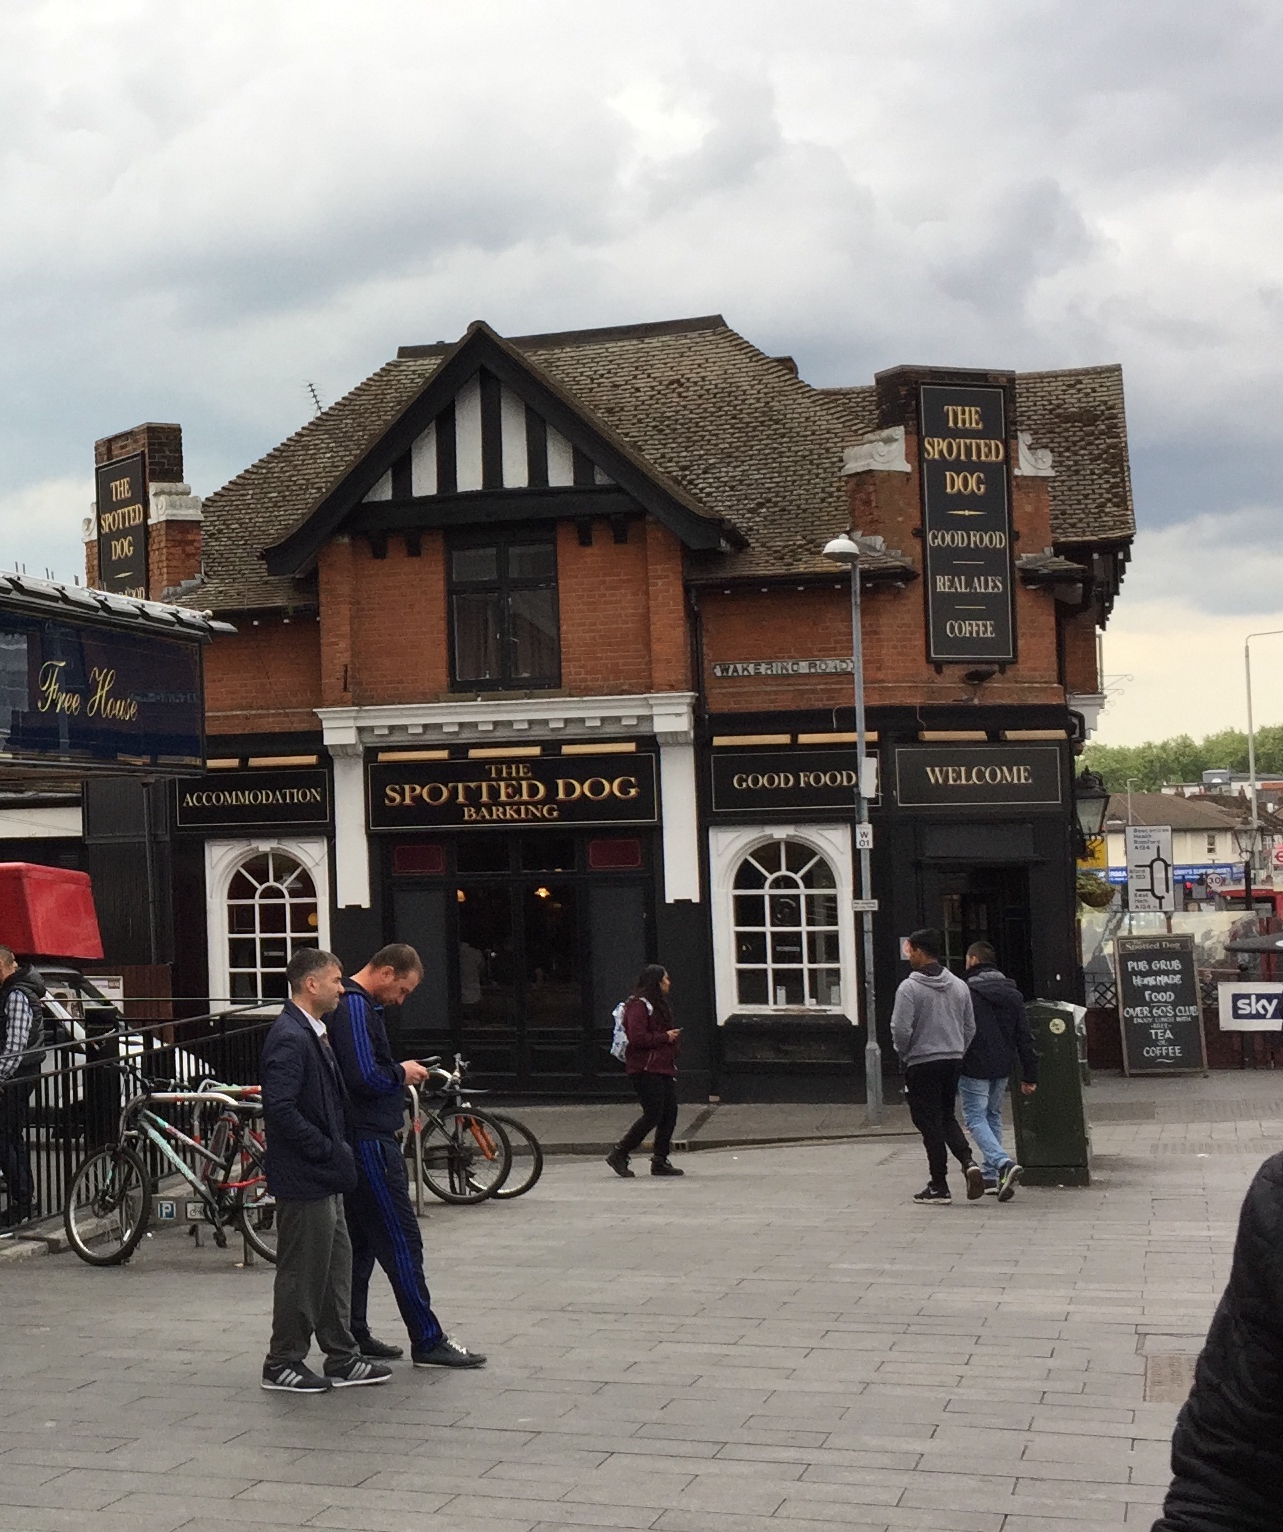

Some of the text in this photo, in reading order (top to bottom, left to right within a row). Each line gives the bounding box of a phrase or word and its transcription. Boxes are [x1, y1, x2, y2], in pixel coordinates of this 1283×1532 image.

[944, 405, 983, 431] THE
[924, 437, 1005, 463] SPOTTED
[110, 477, 132, 502] THE
[945, 471, 987, 496] DOG
[100, 503, 144, 534] SPOTTED
[928, 529, 1005, 548] GOOD FOOD
[111, 536, 134, 561] DOG
[935, 574, 1003, 593] REAL ALES
[946, 620, 995, 639] COFFEE
[719, 658, 849, 677] WAKERING ROAD
[38, 660, 139, 722] Free House
[485, 763, 533, 779] THE
[733, 770, 857, 789] GOOD FOOD
[926, 765, 1033, 786] WELCOME
[183, 787, 323, 808] ACCOMMODATION
[384, 776, 641, 807] SPOTTED DOG
[463, 804, 560, 821] BARKING
[1208, 877, 1221, 885] 30
[1127, 959, 1182, 972] PUB GRUB
[1144, 990, 1175, 1002] FOOD
[1123, 1006, 1151, 1018] OVER
[1175, 1005, 1198, 1017] CLUB
[1237, 994, 1278, 1019] sky
[1148, 1029, 1175, 1040] TEA
[1143, 1046, 1183, 1057] COFFEE
[162, 1203, 172, 1218] P
